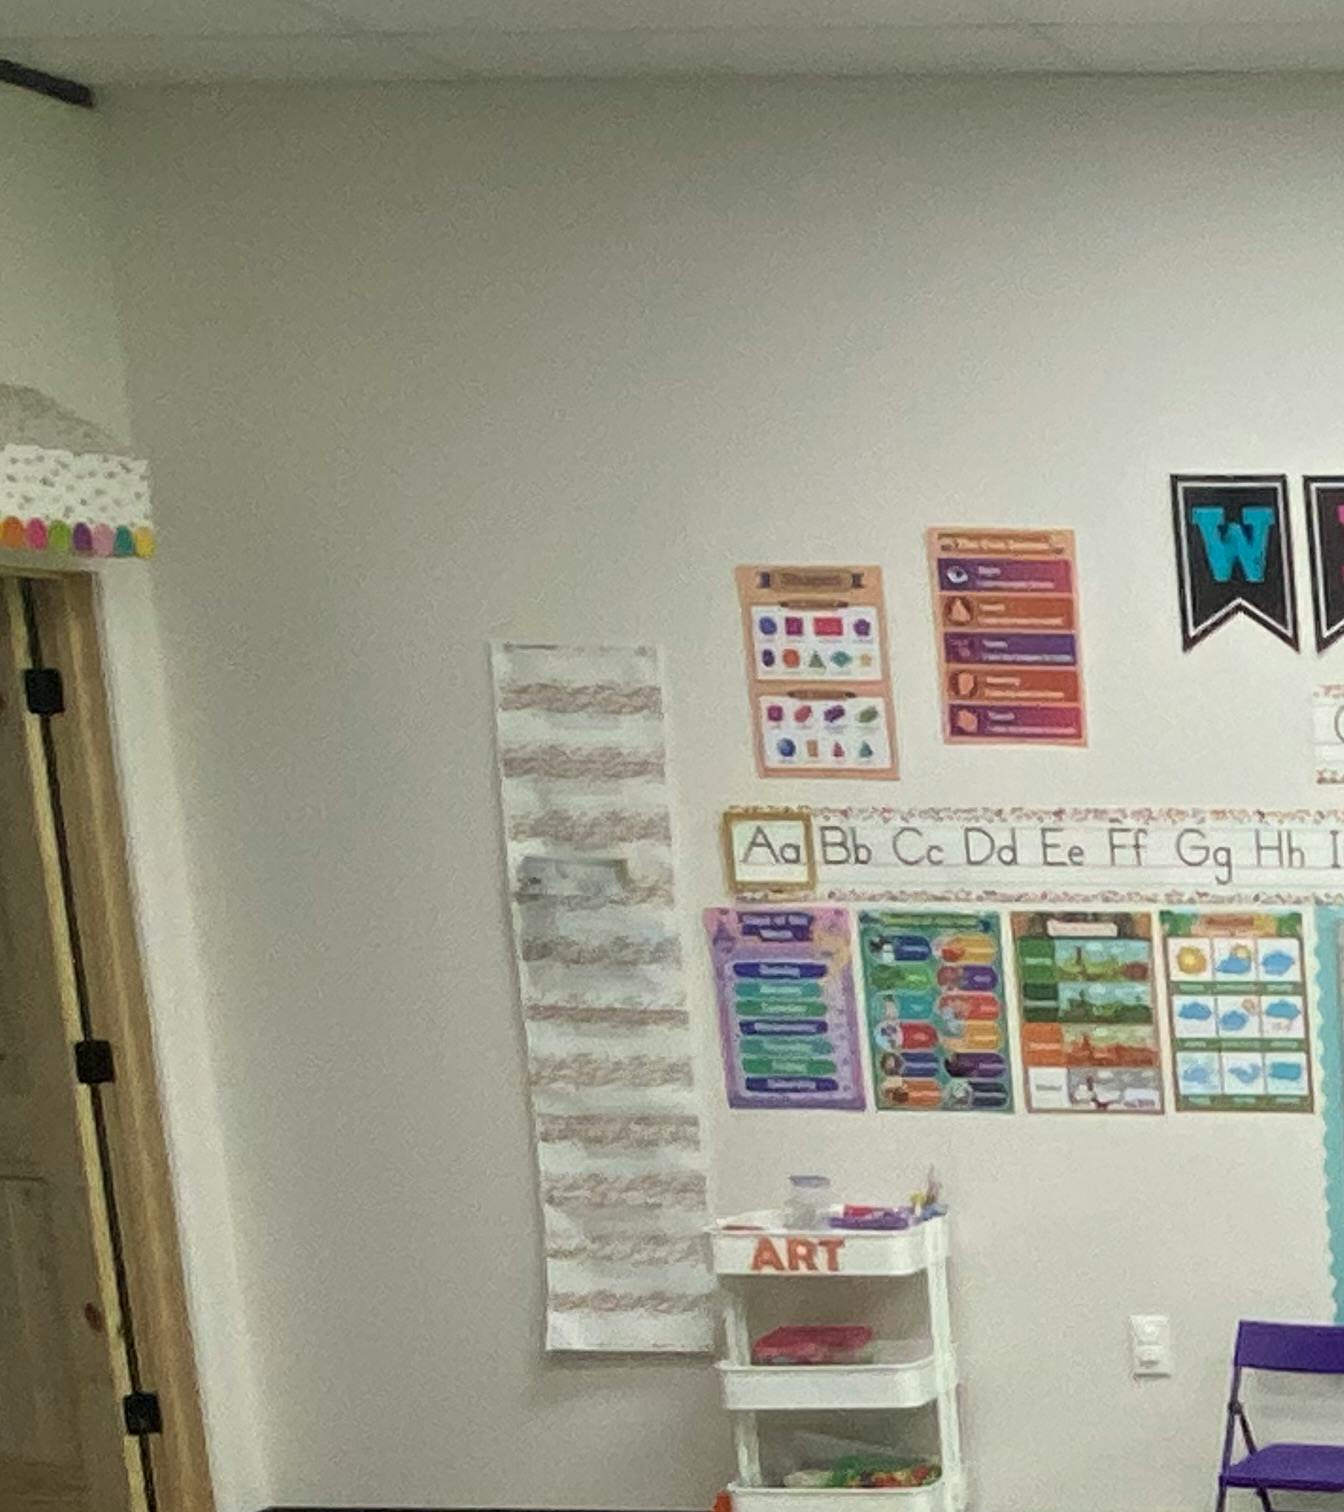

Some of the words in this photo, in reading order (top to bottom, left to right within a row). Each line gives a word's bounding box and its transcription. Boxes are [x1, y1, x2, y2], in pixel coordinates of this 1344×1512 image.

[742, 826, 800, 864] Aa
[819, 826, 872, 865] Bb
[892, 826, 944, 866] Cc
[963, 826, 1018, 866] Dd
[1040, 827, 1085, 867] Ee
[1108, 828, 1149, 867] Ff
[1175, 828, 1232, 886] Gg
[1254, 828, 1305, 869] Hh
[751, 1237, 845, 1271] ART
